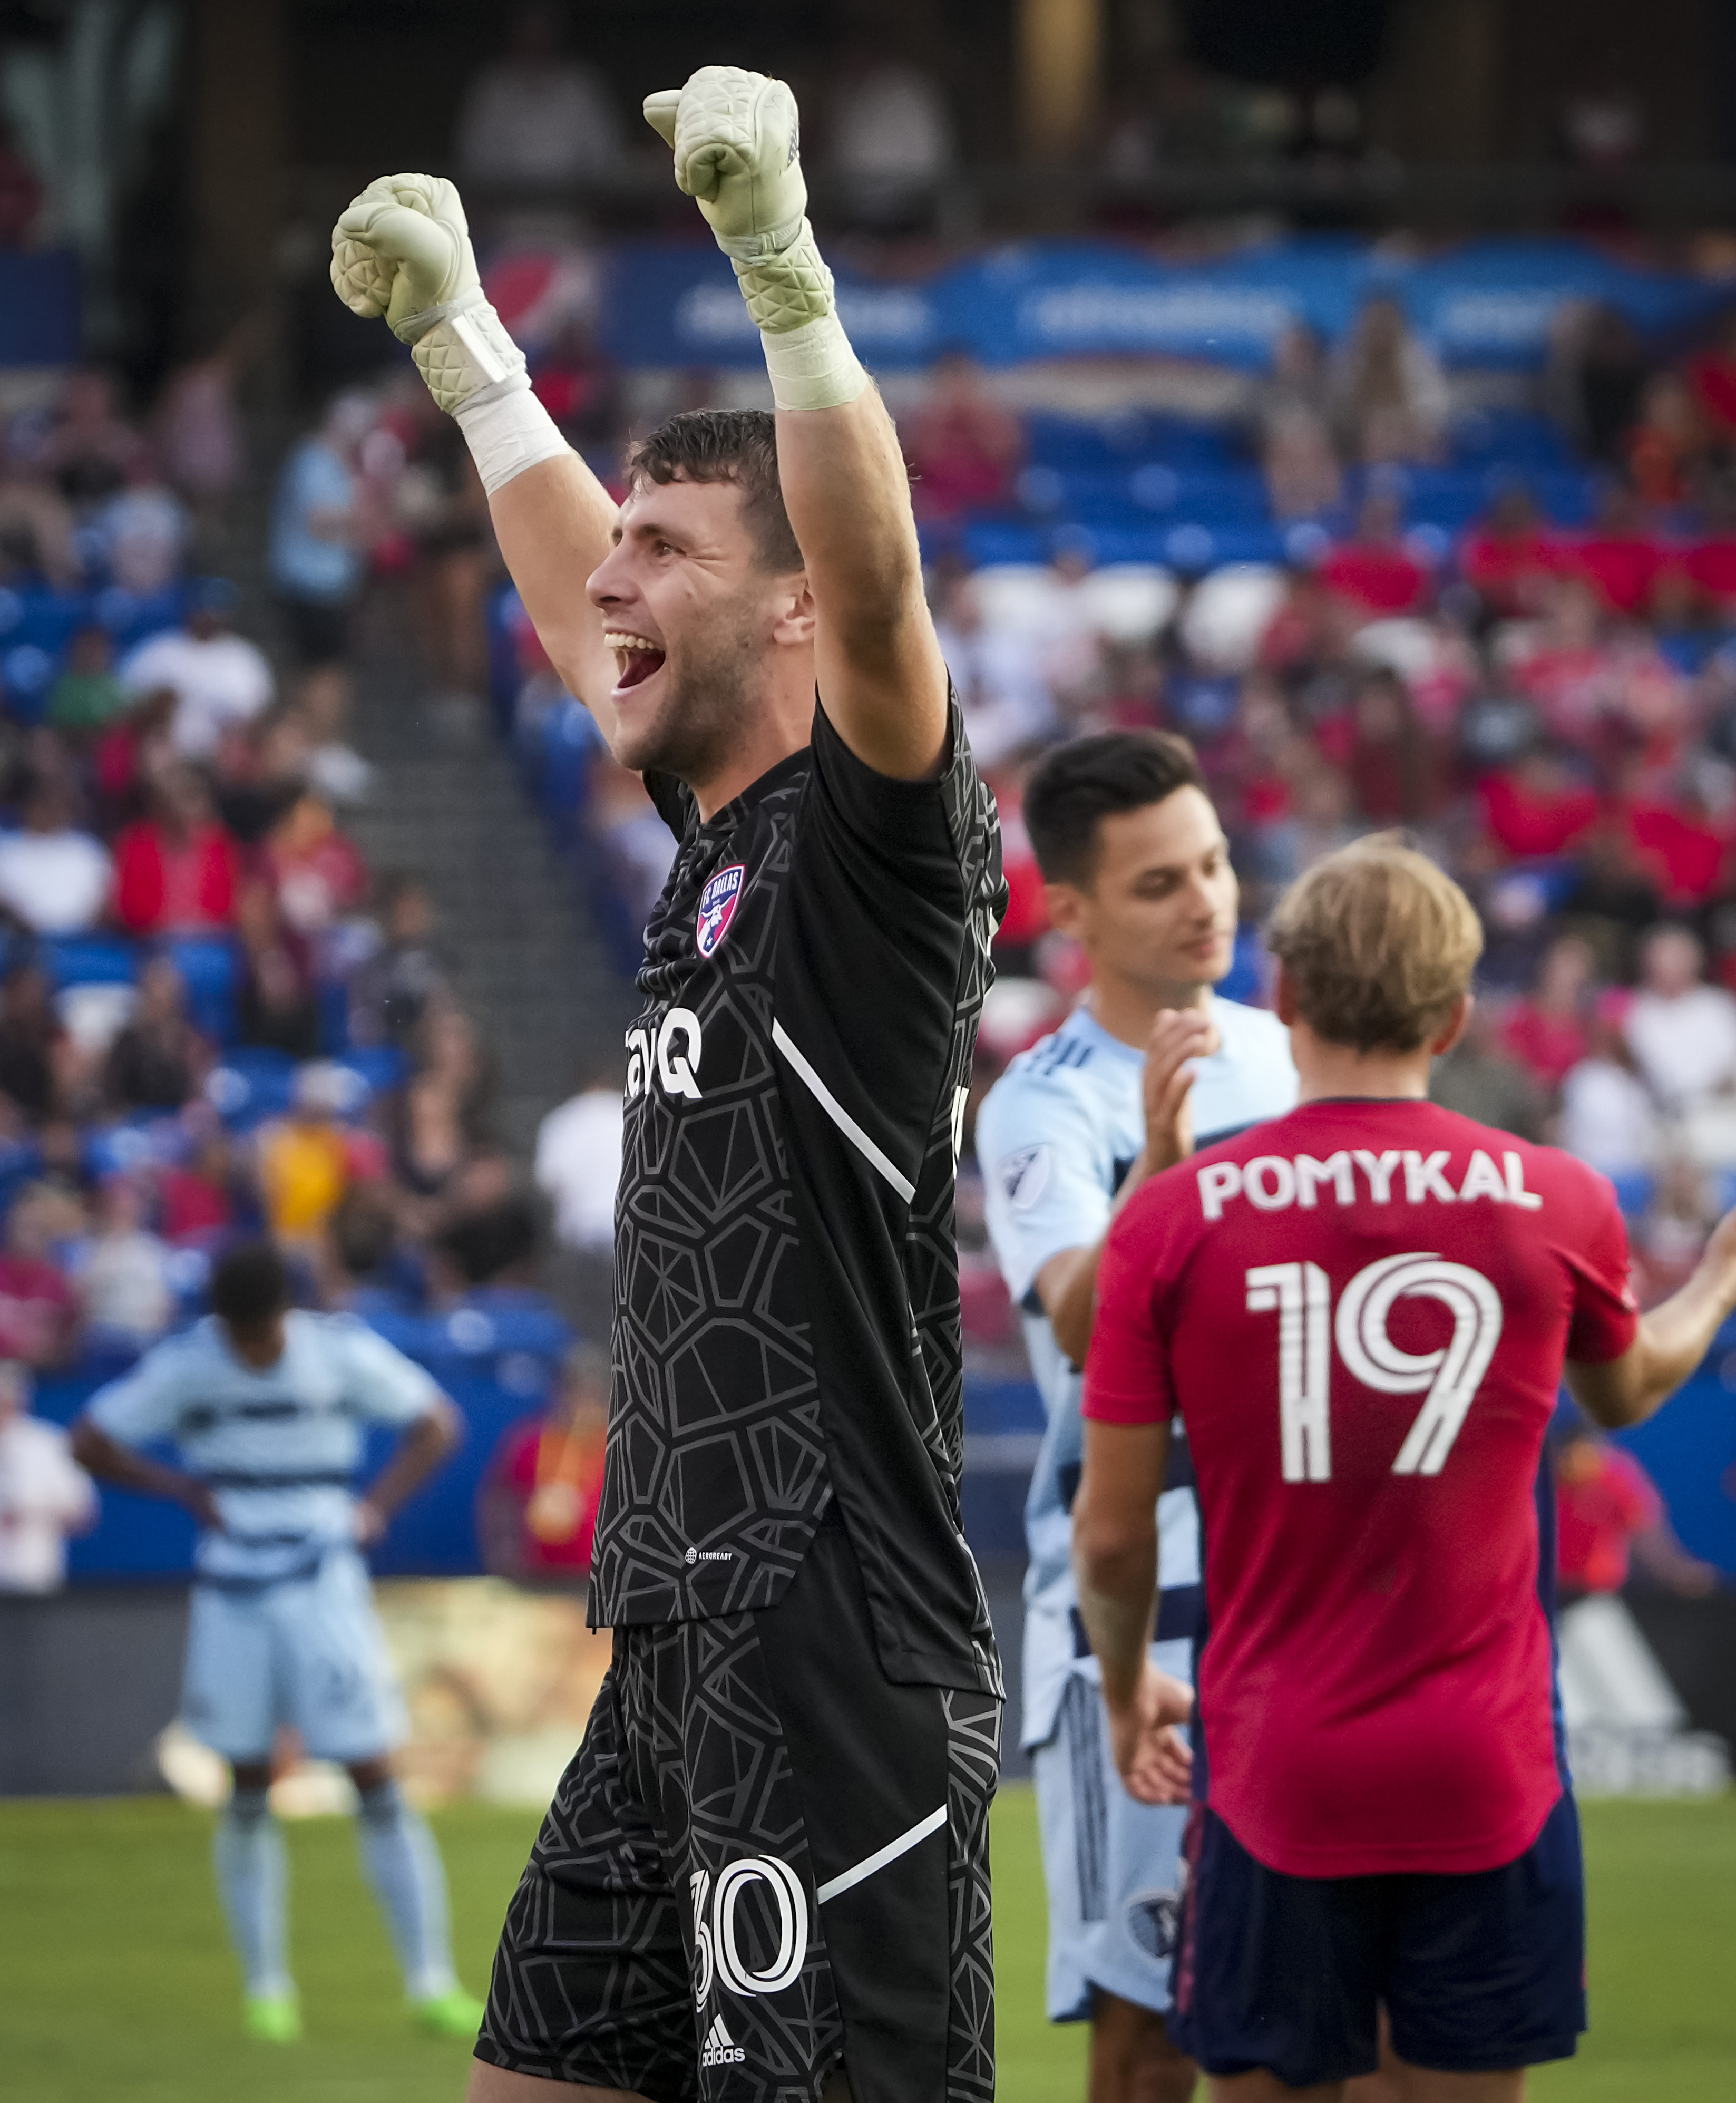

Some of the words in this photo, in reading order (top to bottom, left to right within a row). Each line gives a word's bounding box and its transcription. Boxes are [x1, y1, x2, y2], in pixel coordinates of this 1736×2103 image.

[702, 886, 711, 909] FC
[711, 871, 738, 899] DALLAS
[1196, 1149, 1543, 1222] POMYKAL
[1245, 1252, 1504, 1483] 19
[698, 1552, 732, 1561] AEROREADY
[689, 1854, 808, 2013] 30
[702, 2046, 746, 2067] adidas
